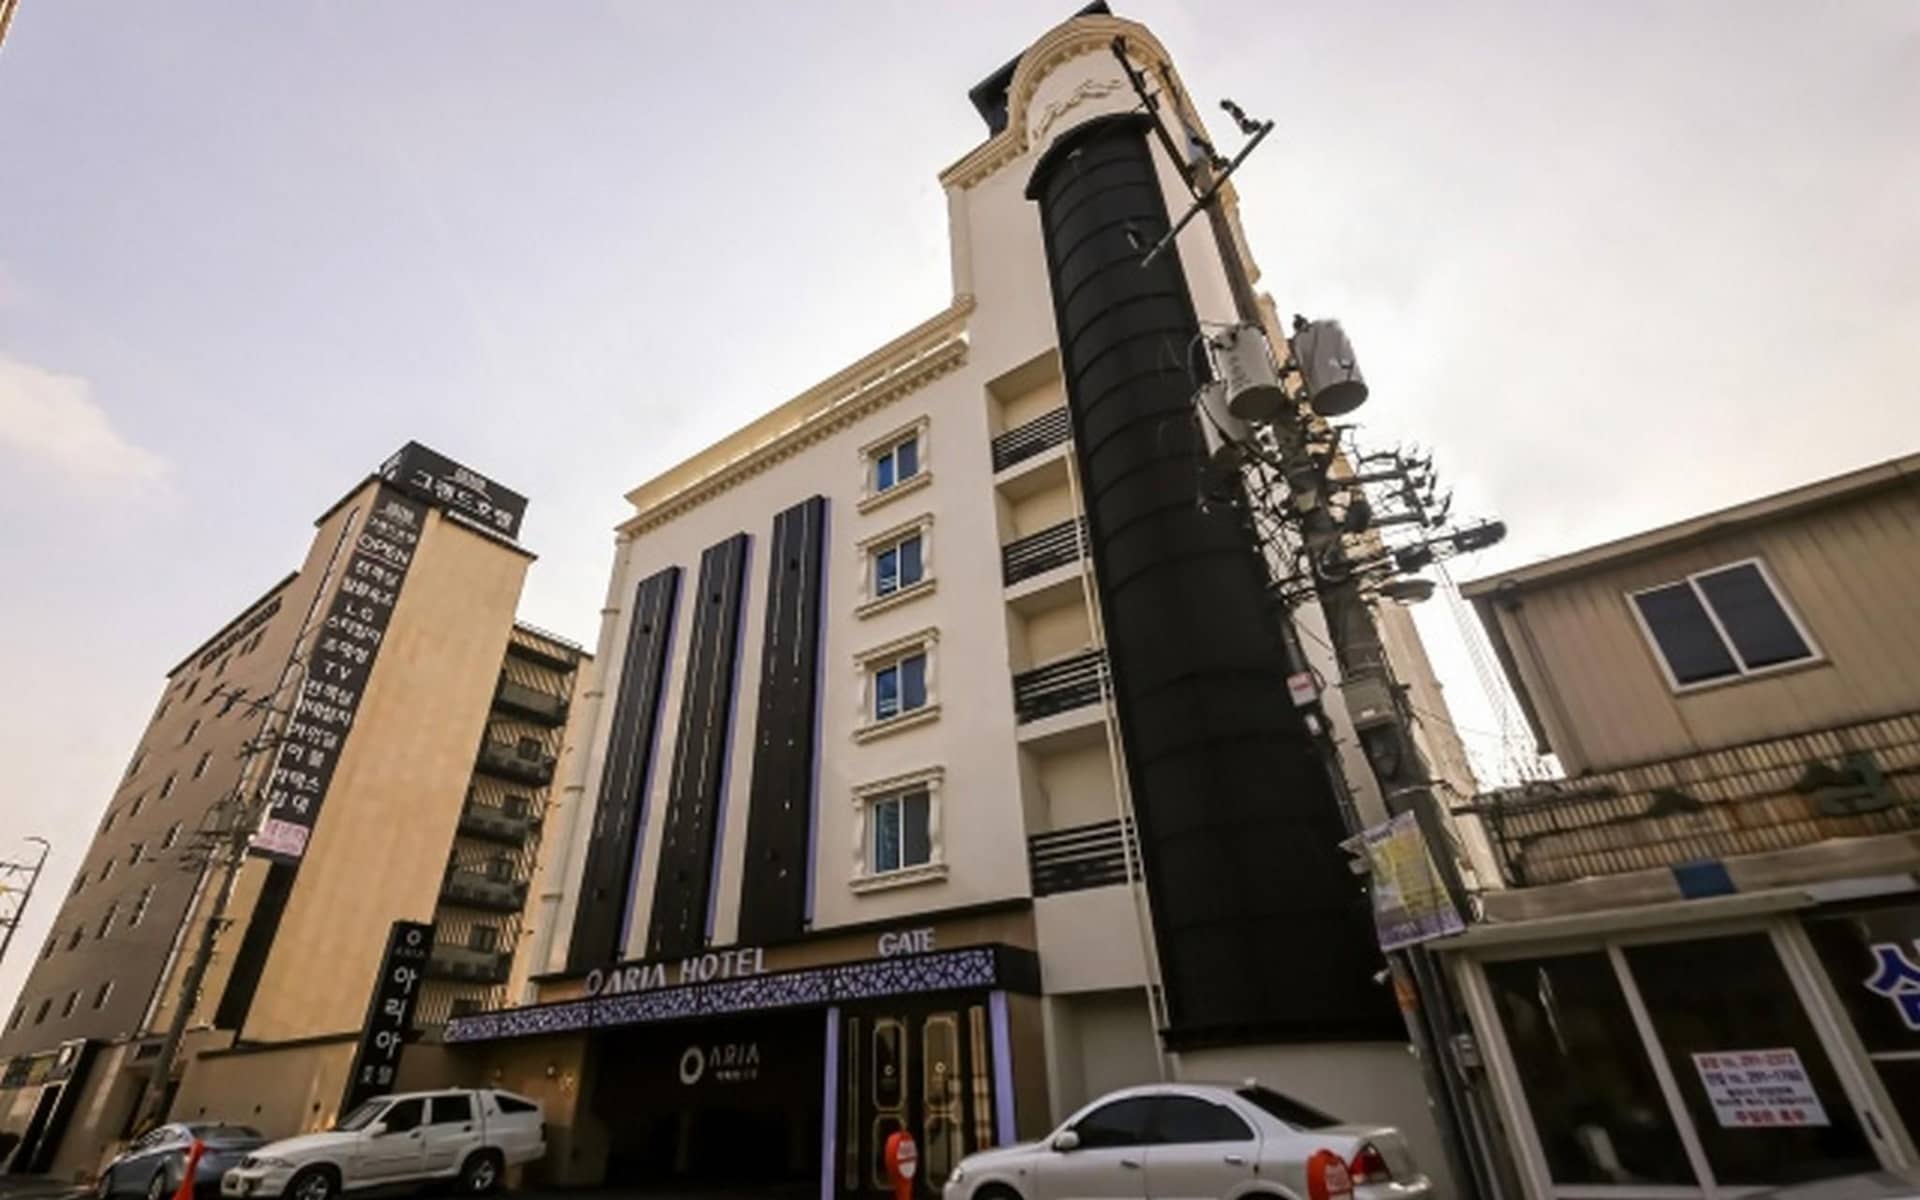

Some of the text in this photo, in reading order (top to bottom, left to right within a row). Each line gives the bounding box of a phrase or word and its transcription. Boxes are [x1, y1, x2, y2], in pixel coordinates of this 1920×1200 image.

[358, 533, 411, 565] OPEN
[324, 660, 352, 679] TV
[878, 928, 936, 957] GATE
[602, 948, 768, 994] ARIA HOTEL
[708, 1043, 760, 1066] ARIA
